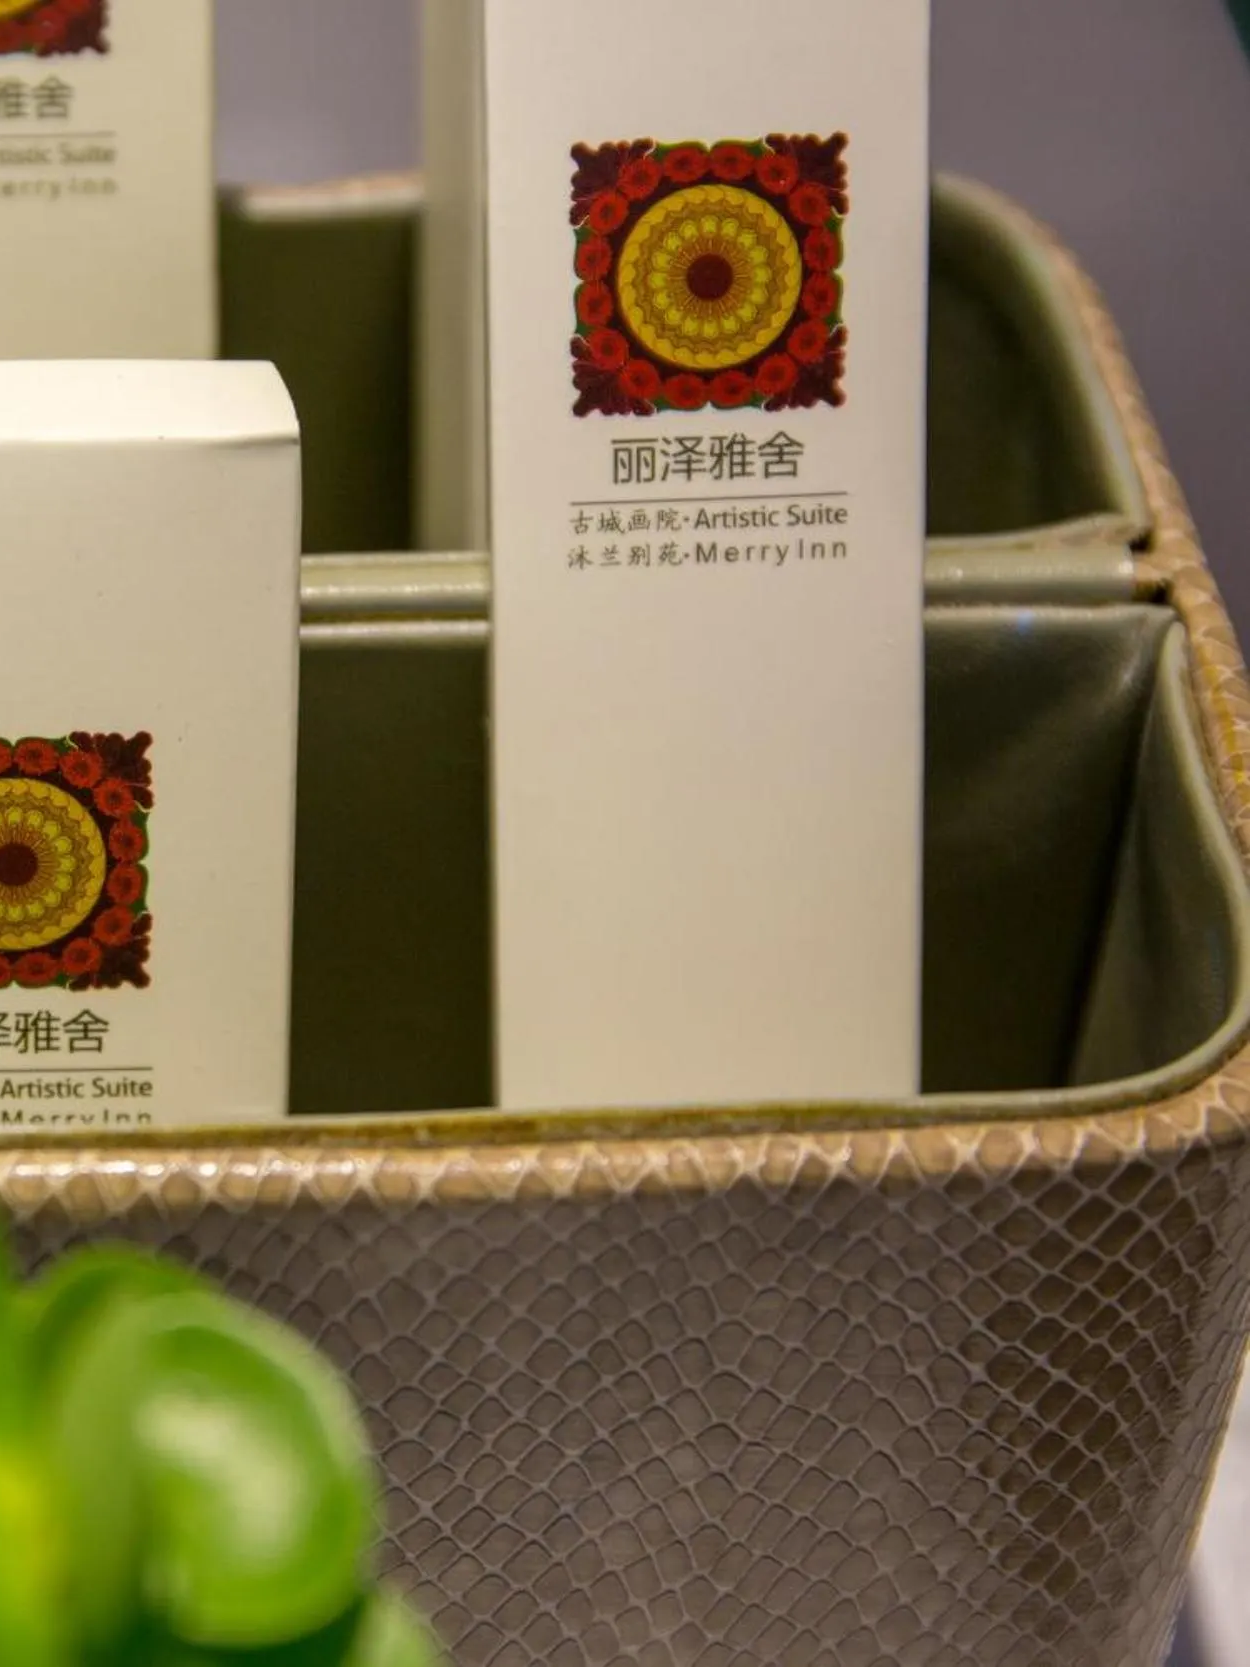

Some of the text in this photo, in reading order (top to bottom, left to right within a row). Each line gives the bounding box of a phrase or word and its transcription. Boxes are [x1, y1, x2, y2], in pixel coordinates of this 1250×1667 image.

[610, 430, 805, 484] 丽泽雅舍
[786, 504, 848, 526] Suite
[91, 1076, 153, 1098] Suite
